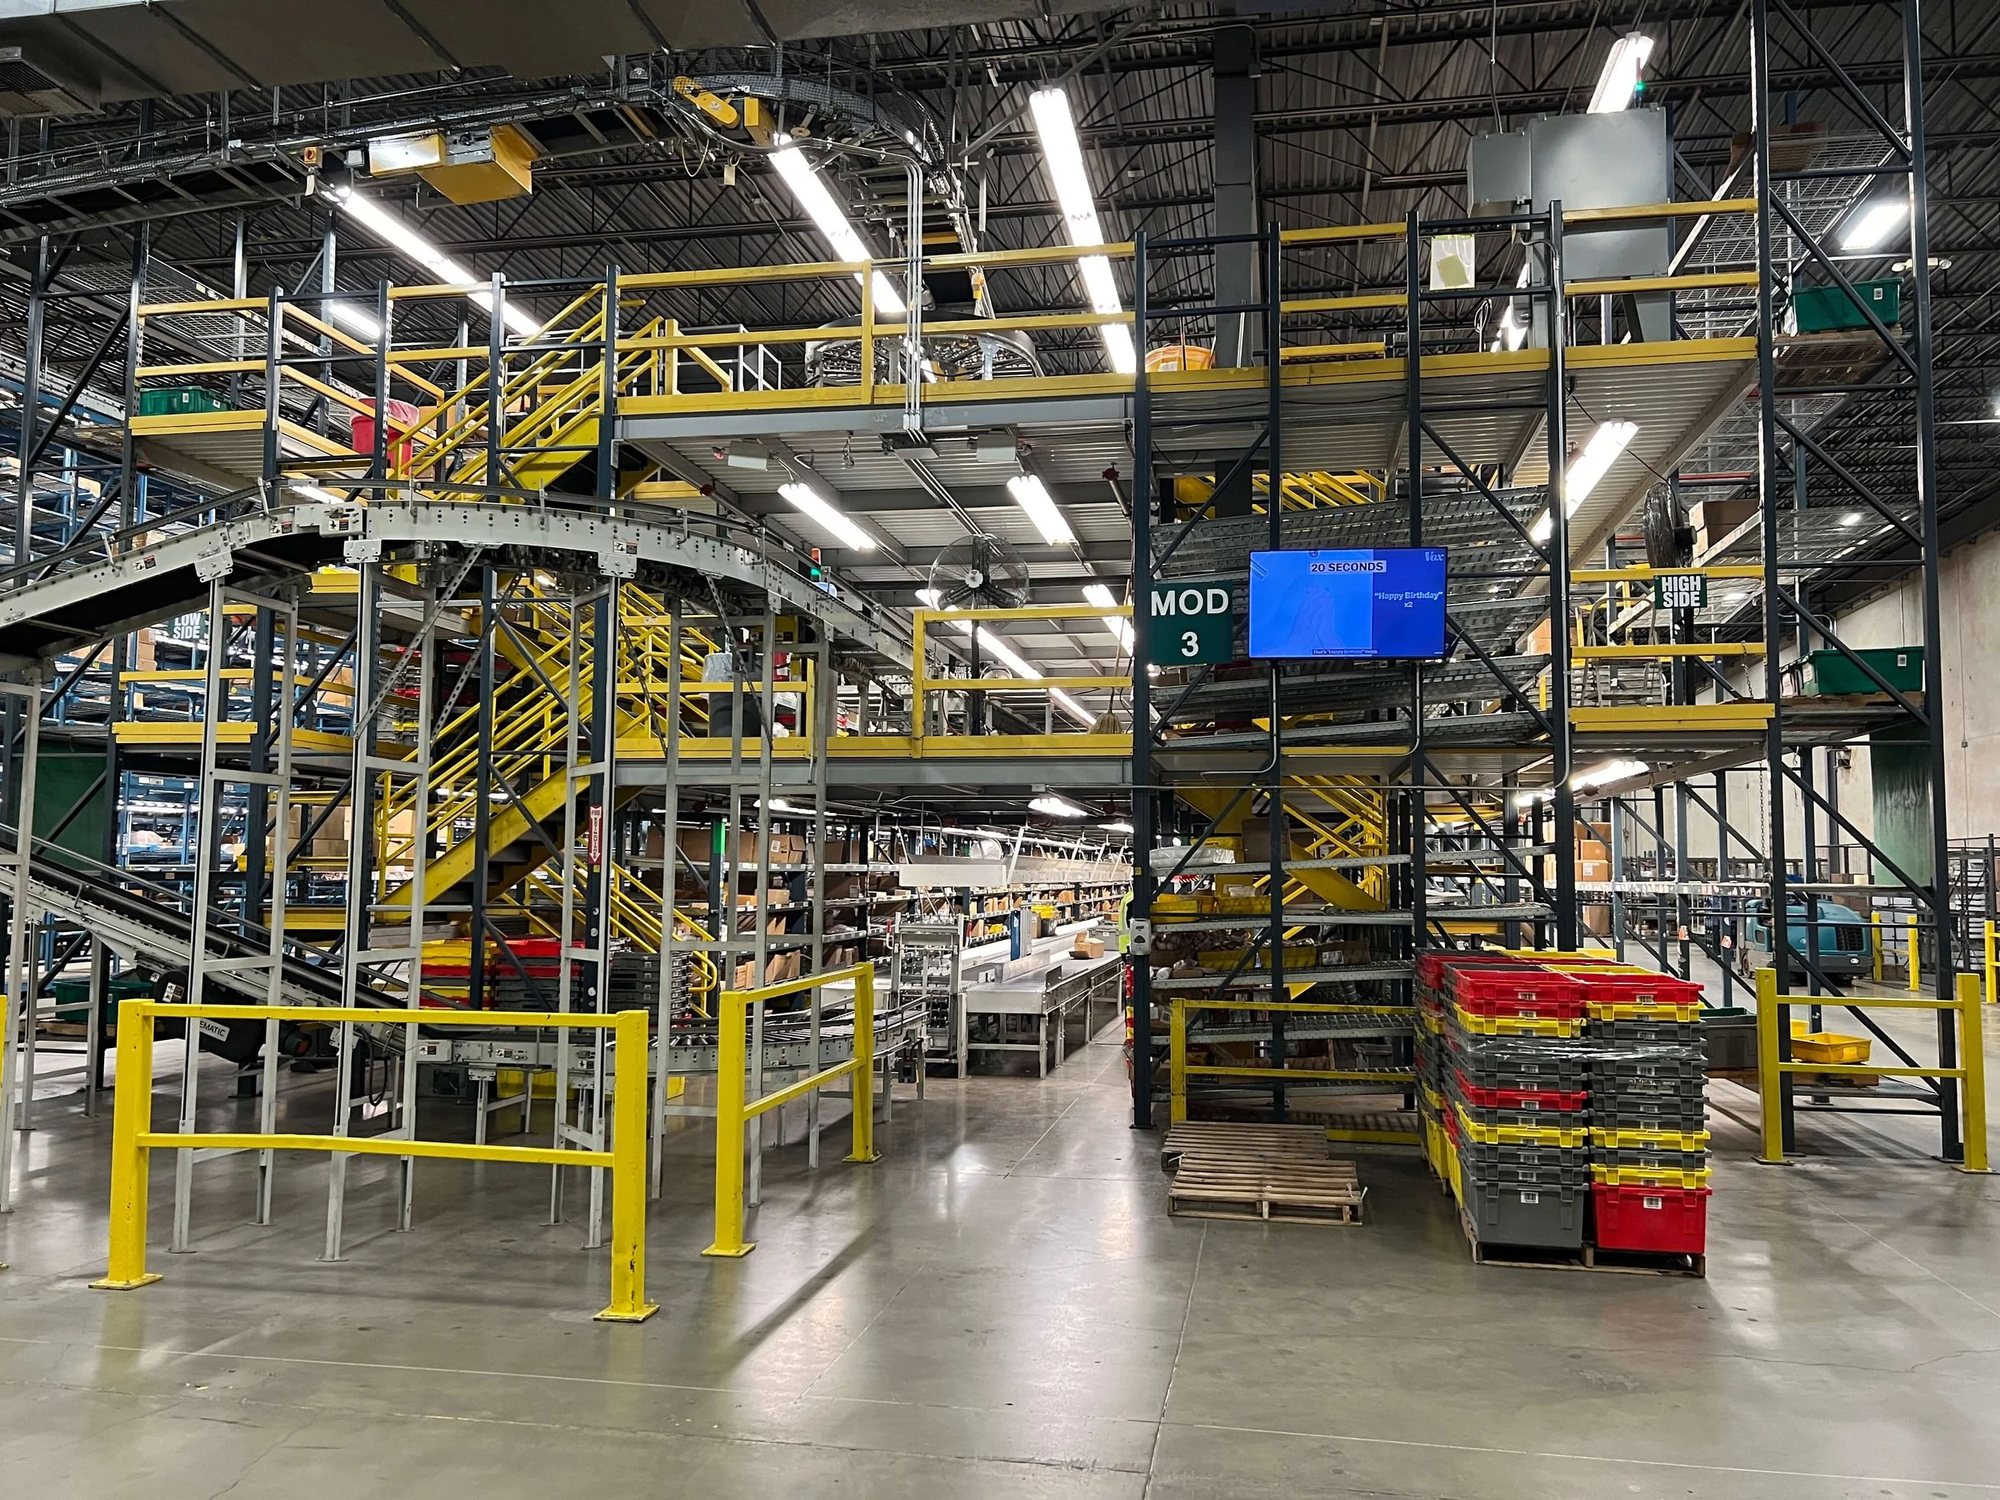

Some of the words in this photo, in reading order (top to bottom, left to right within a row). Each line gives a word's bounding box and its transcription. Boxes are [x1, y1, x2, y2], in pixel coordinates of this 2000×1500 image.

[1311, 563, 1325, 572] 20
[1328, 562, 1383, 572] SECONDS
[1661, 576, 1701, 592] HIGH
[1151, 589, 1229, 616] MOD
[1663, 591, 1700, 607] SIDE
[174, 612, 201, 626] LOW
[172, 625, 200, 639] SIDE
[1181, 631, 1199, 657] 3
[200, 1020, 226, 1037] EMATIC
